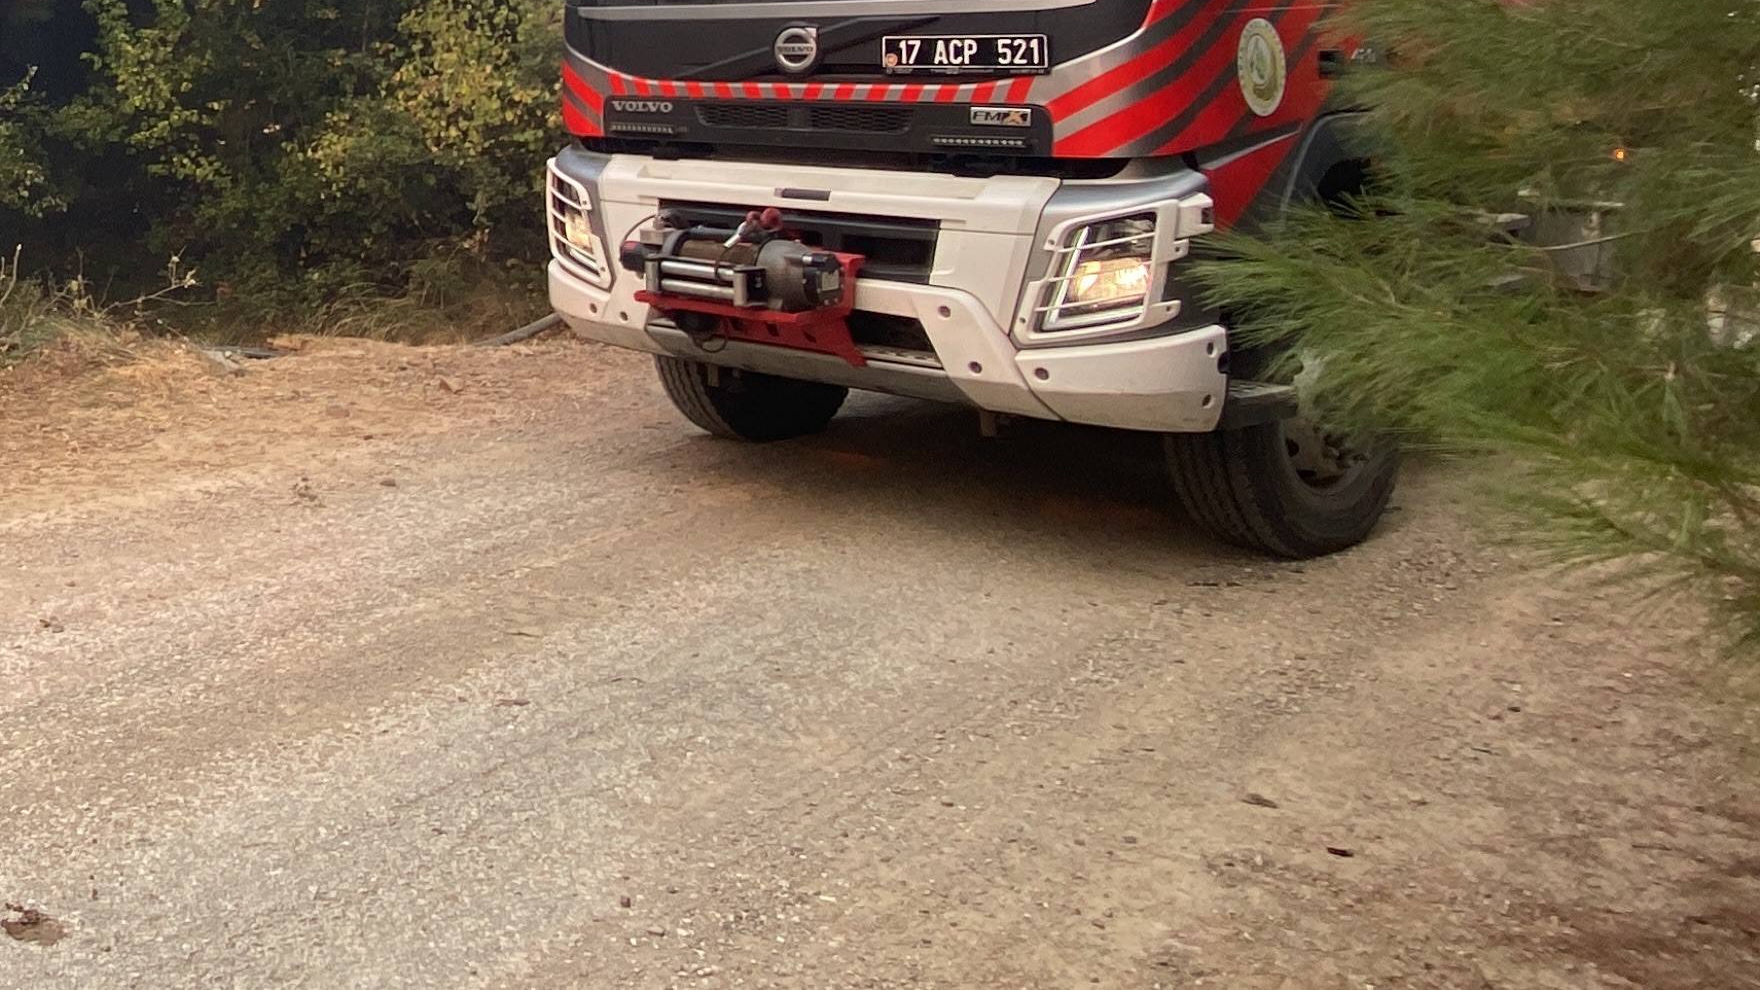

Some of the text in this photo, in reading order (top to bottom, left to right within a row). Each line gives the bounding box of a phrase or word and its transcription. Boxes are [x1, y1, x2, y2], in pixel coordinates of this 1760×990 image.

[899, 38, 1040, 65] 17 ACP 521
[611, 100, 673, 113] VOLVO
